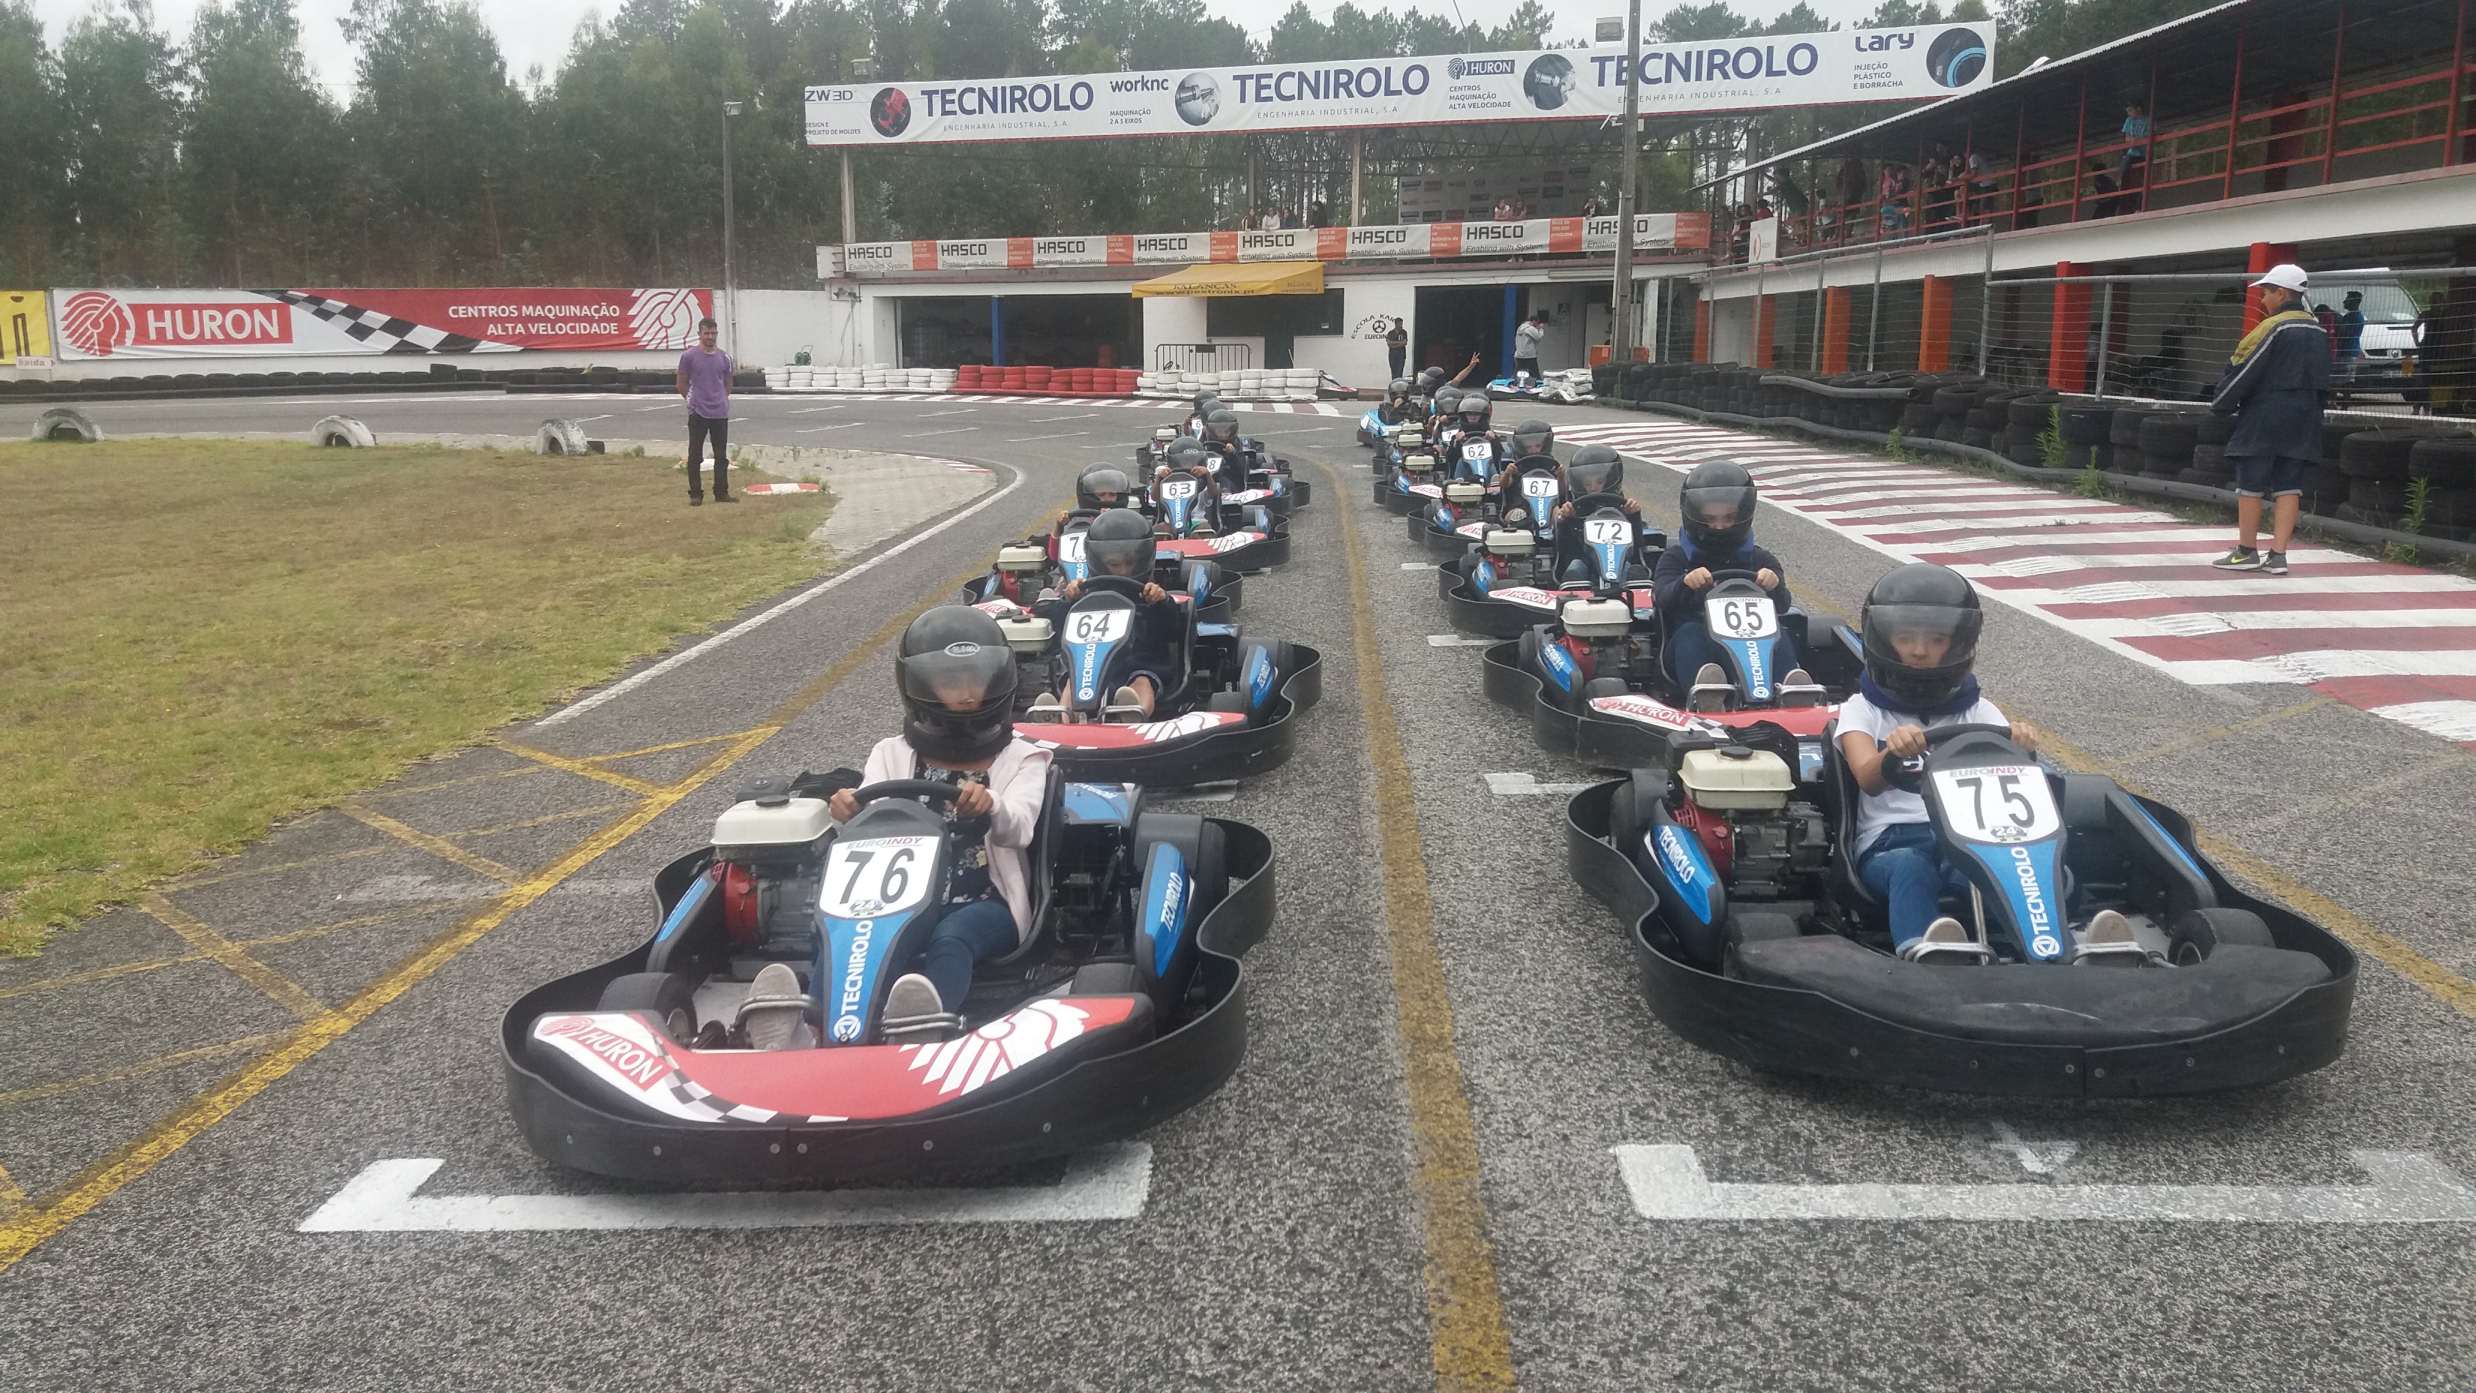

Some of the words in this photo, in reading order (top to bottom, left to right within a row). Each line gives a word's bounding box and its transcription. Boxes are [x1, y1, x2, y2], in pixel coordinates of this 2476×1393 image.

[1471, 62, 1512, 74] HURON
[1590, 42, 1819, 88] TECNIROLO
[1110, 75, 1169, 93] worknc
[1233, 64, 1430, 103] TECNIROLO
[1449, 85, 1481, 93] CENTROS
[1860, 80, 1903, 89] BORRACHA
[921, 81, 1094, 118] TECNIROLO
[1449, 92, 1497, 101] MAQUINAÇÃO
[1468, 101, 1511, 109] VELOCIDADE
[1257, 109, 1315, 119] ENGENHARIA
[1467, 225, 1523, 240] HASCO
[1587, 219, 1648, 235] HASO
[1138, 238, 1187, 251] HASCO
[1243, 234, 1294, 248] HASCO
[1351, 231, 1406, 244] HASCO
[849, 247, 892, 259] HASCO
[941, 244, 987, 256] HASCO
[1038, 241, 1085, 254] HASCO
[449, 305, 518, 318] CENTROS
[522, 302, 620, 319] MAQUINAÇÃO
[147, 309, 280, 340] HURON
[487, 323, 525, 336] ALTA
[528, 322, 619, 335] VELOCIDADE
[1468, 445, 1485, 457] 62
[1169, 482, 1191, 496] 63
[1530, 481, 1550, 494] 67
[1594, 522, 1622, 540] 72
[1724, 601, 1763, 631] 65
[1076, 613, 1111, 639] 64
[1081, 643, 1097, 687] TECNIROLO
[1746, 640, 1764, 686] TECNIROLO
[1625, 701, 1686, 725] HURON
[1956, 775, 2035, 830] 75
[1658, 826, 1695, 884] TECNIROLO
[840, 847, 915, 905] 76
[2011, 846, 2050, 935] TECNIROLO
[841, 920, 874, 1016] TECNIROLO
[579, 1027, 663, 1084] HURON
